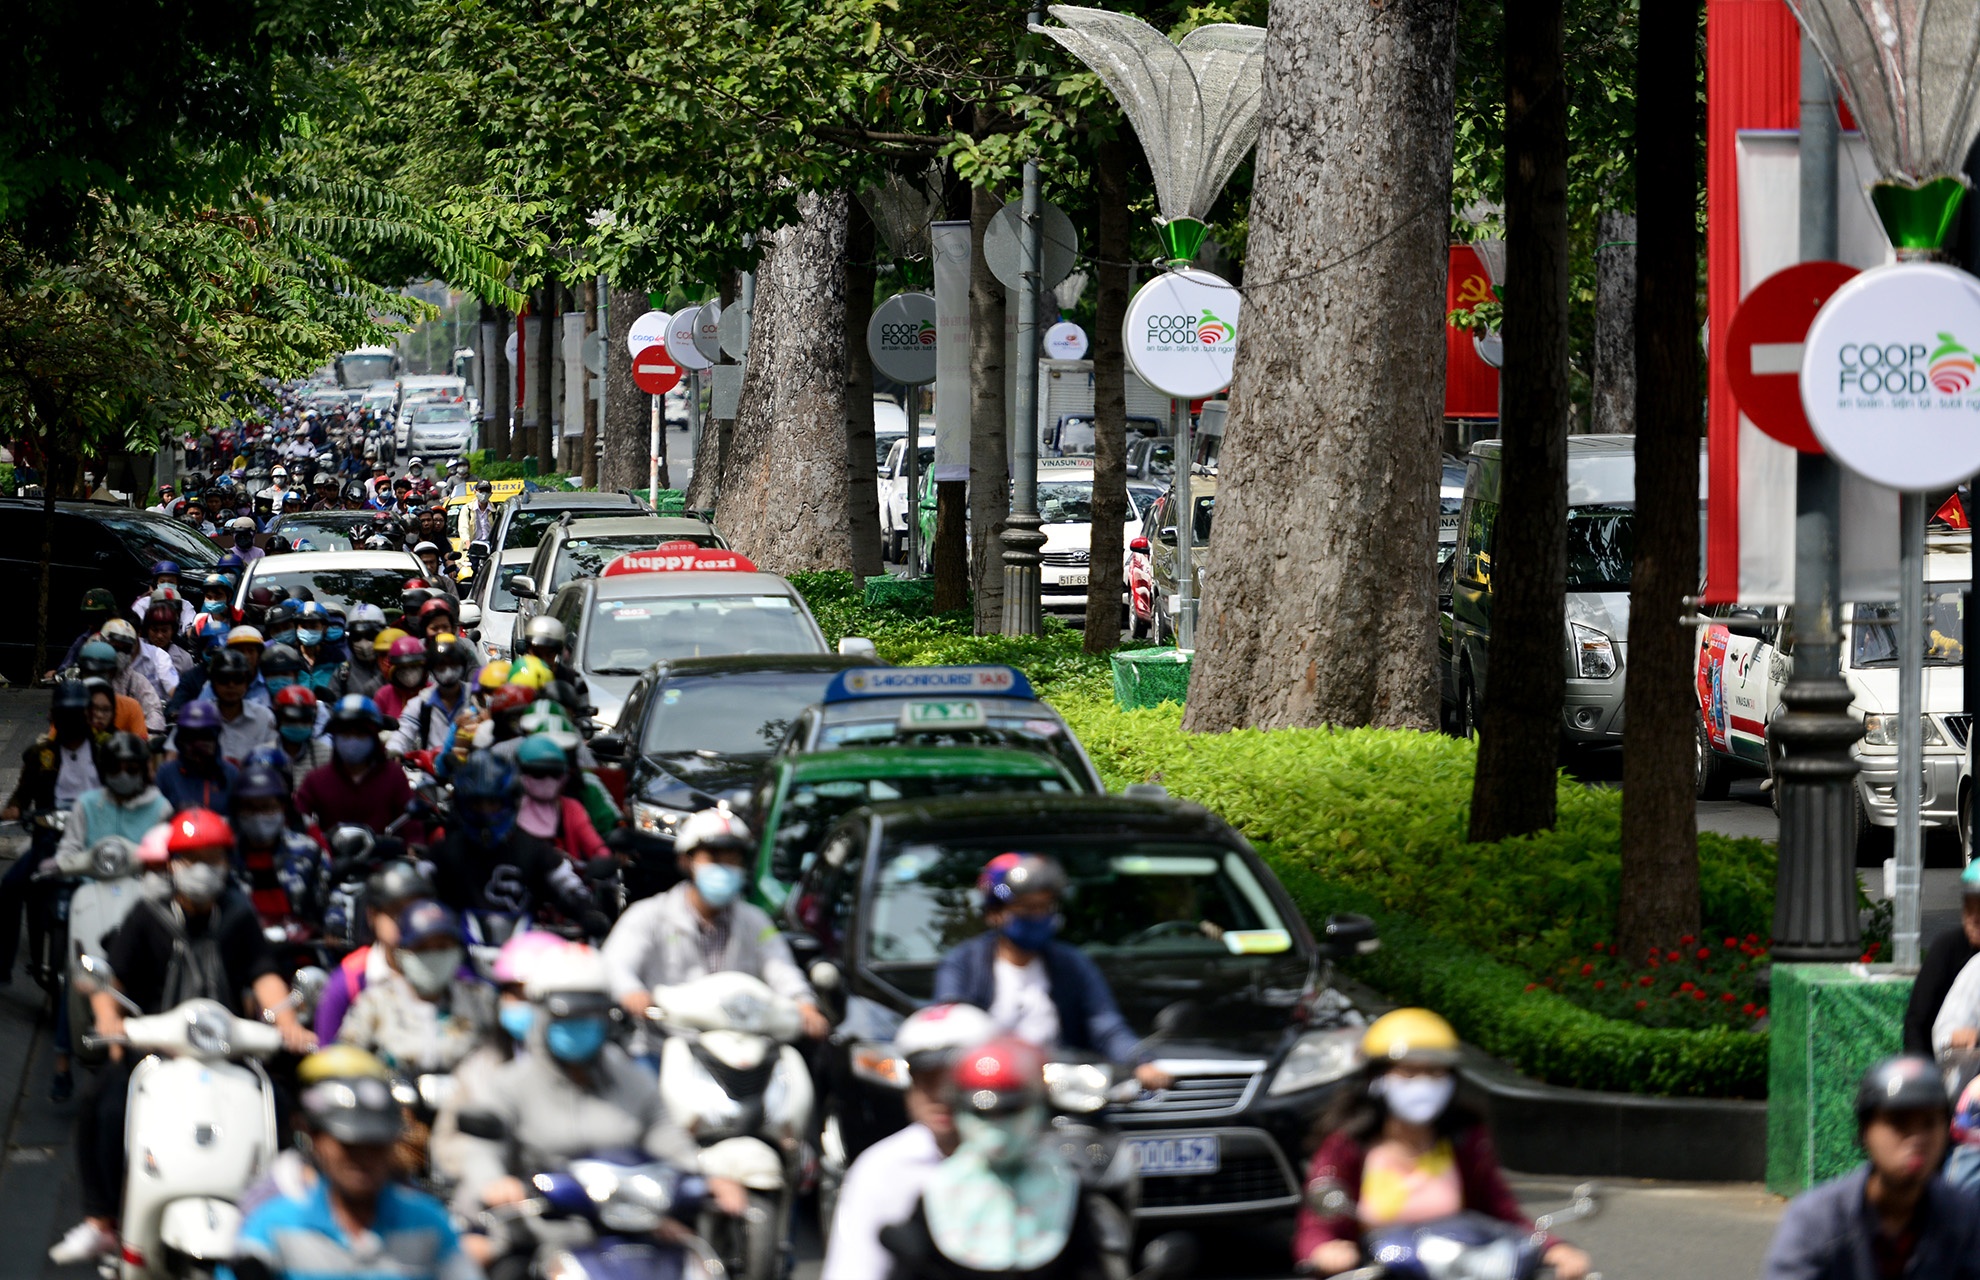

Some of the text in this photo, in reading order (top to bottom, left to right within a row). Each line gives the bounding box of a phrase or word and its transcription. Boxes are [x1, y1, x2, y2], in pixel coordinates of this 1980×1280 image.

[881, 334, 919, 345] FOOD
[1147, 330, 1197, 344] FOOD
[1839, 369, 1927, 395] FOOD
[622, 555, 696, 570] happy
[873, 672, 1008, 686] SAIGONTOURIST TAXI
